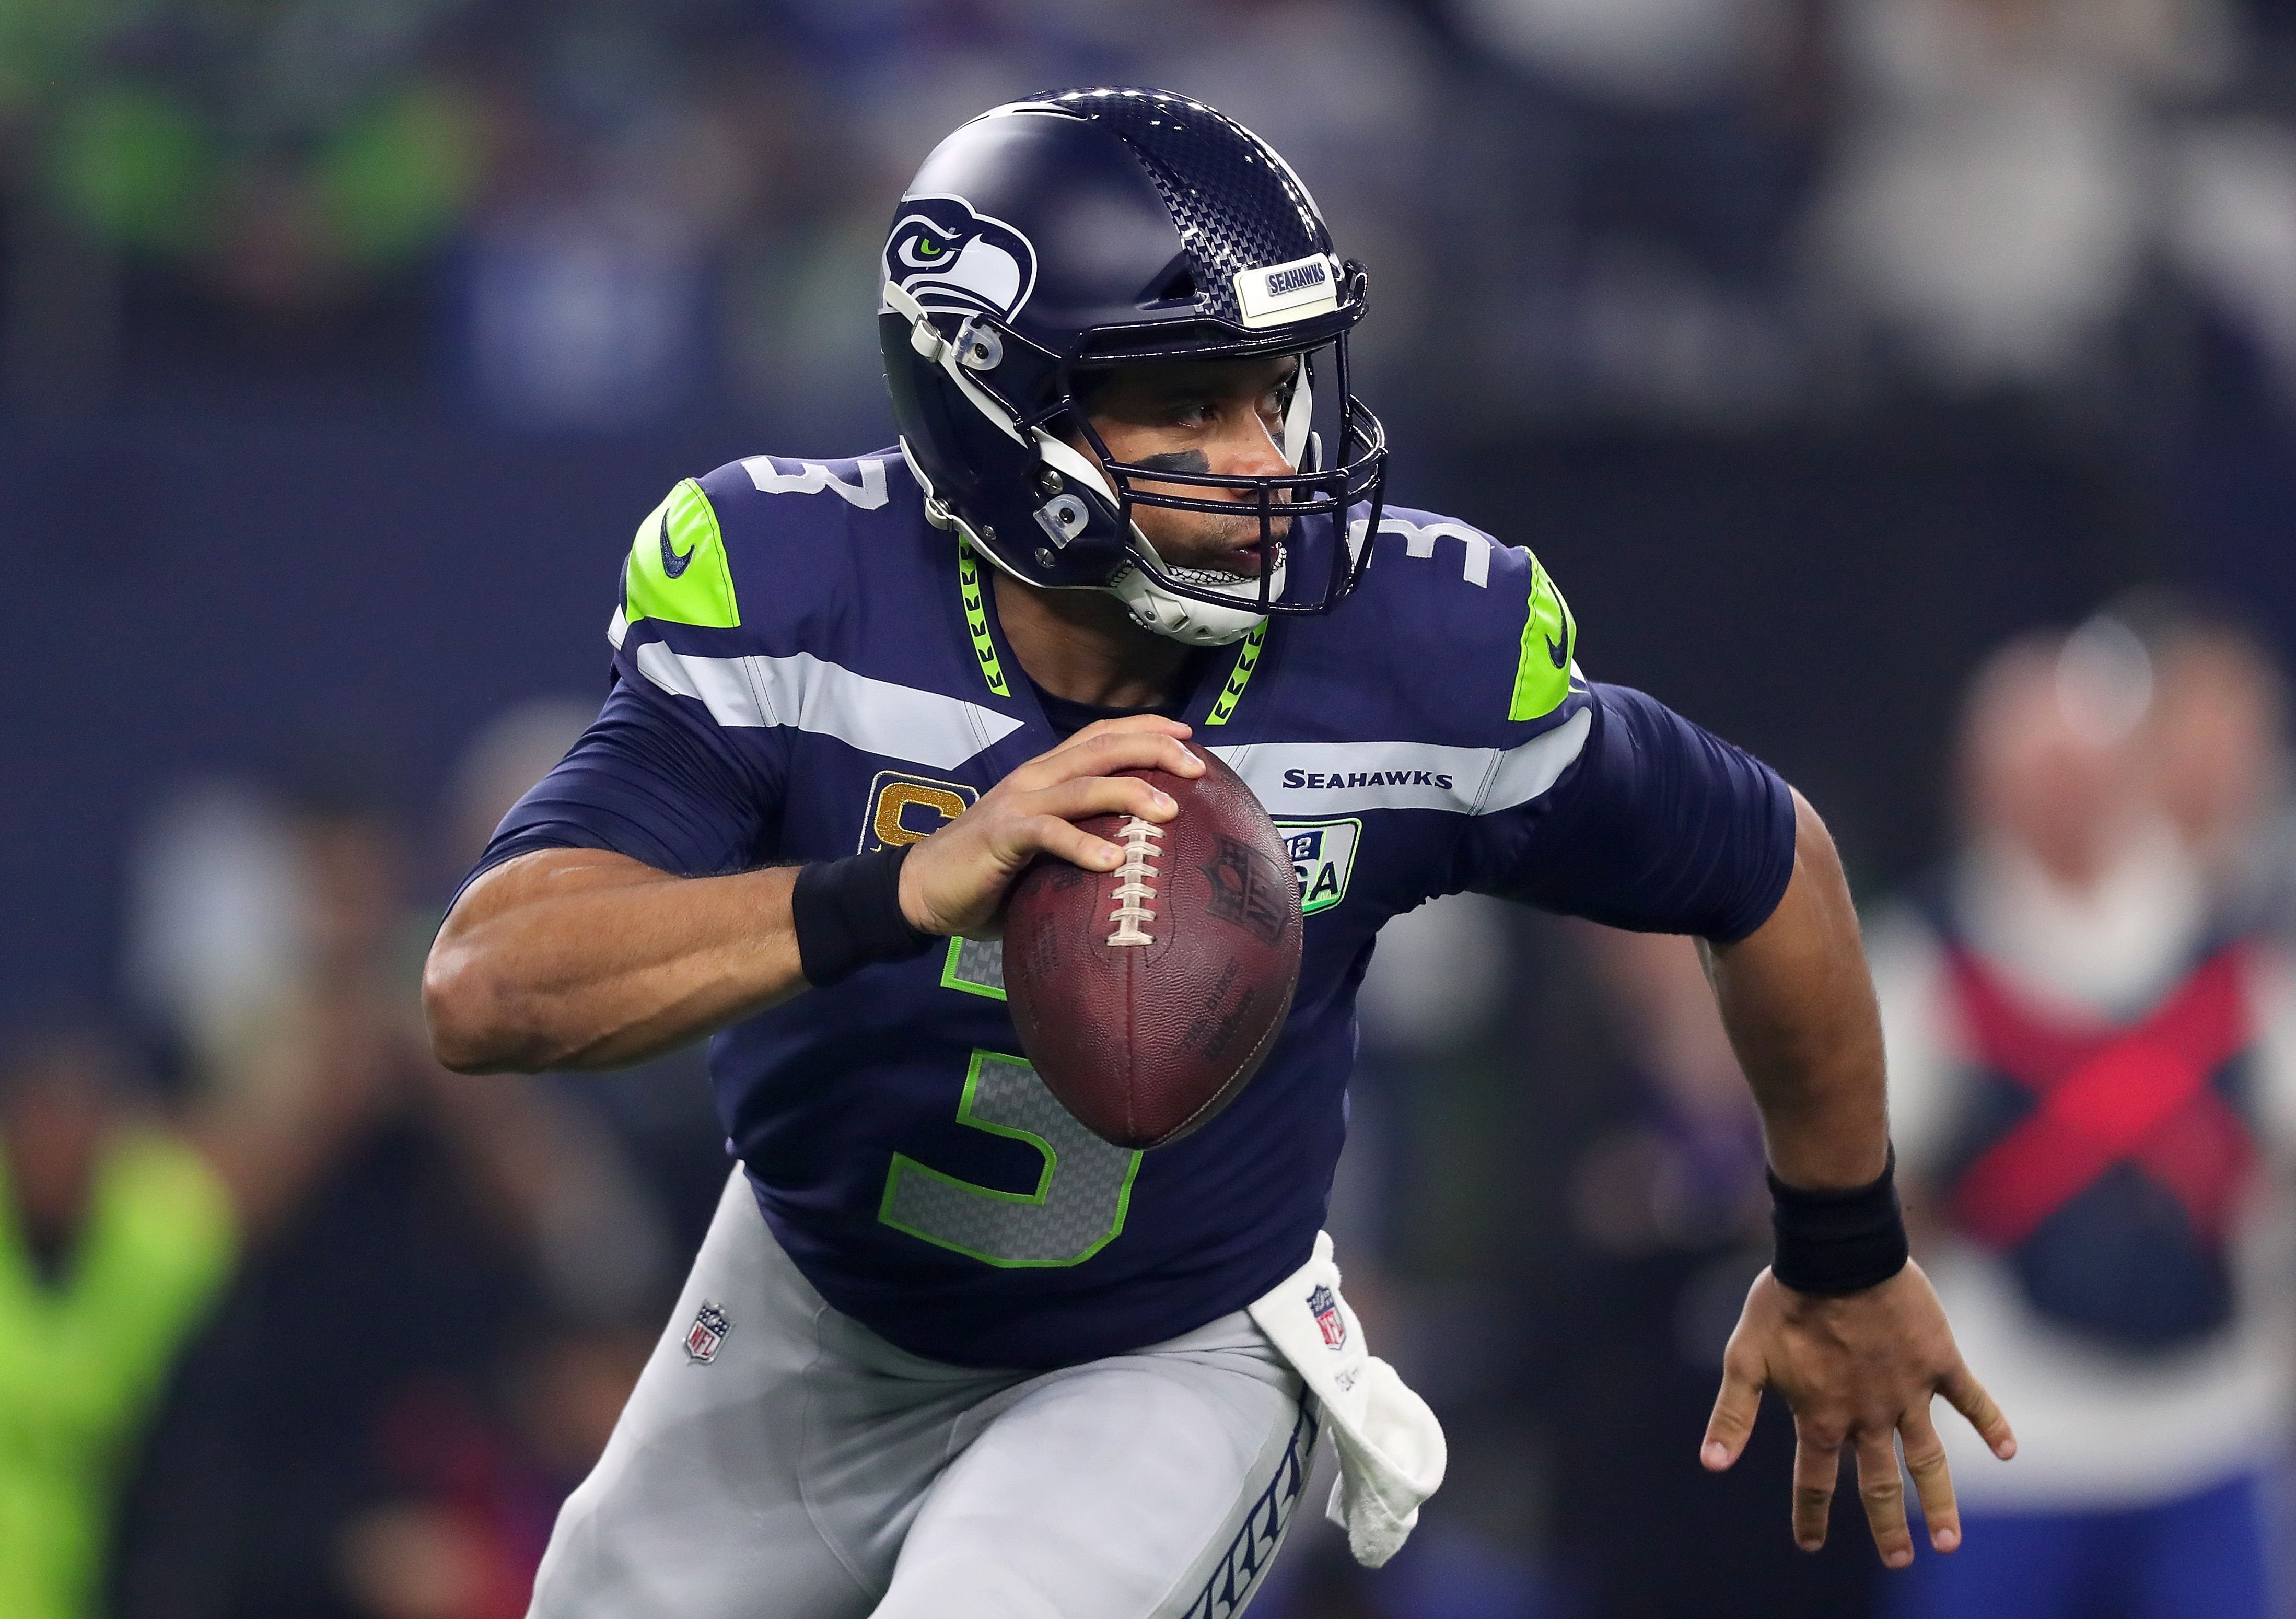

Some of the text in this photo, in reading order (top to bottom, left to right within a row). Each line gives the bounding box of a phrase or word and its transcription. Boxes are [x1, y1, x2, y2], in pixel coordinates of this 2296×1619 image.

[1269, 263, 1325, 294] SEAHAWKS
[741, 456, 889, 510] 3
[1350, 519, 1490, 589] 3
[1287, 837, 1312, 858] 12
[689, 1324, 716, 1356] NFL
